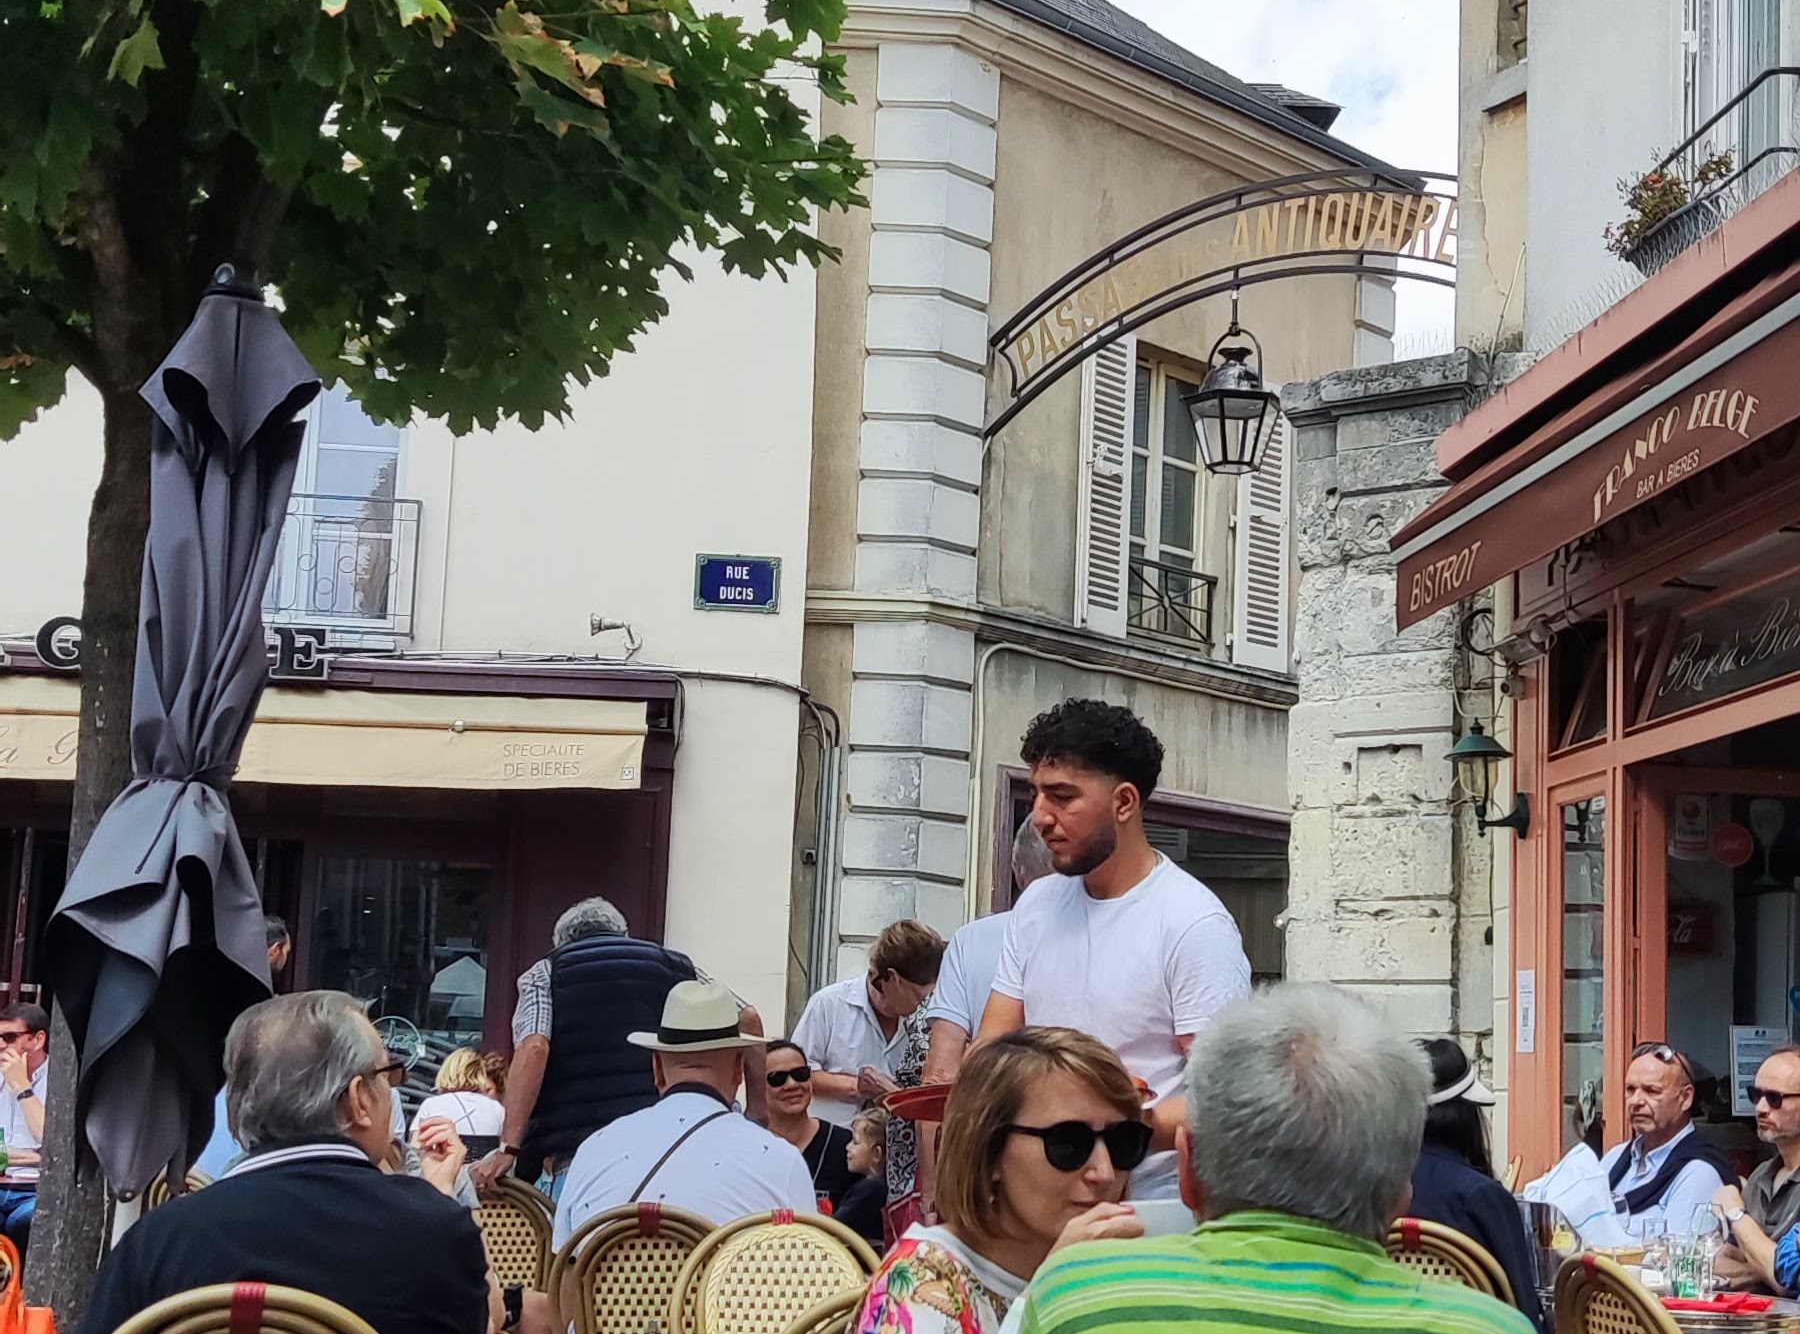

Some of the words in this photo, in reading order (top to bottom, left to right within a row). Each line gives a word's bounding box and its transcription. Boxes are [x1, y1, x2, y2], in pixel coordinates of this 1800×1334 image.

[1593, 406, 1681, 524] FRANCO
[1687, 389, 1760, 439] BELGE
[1636, 474, 1655, 499] BAR
[1655, 469, 1664, 490] A
[1666, 448, 1700, 483] BIERES
[726, 565, 751, 580] RUE
[1409, 540, 1482, 612] BISTROT
[719, 586, 754, 601] DUCIS
[503, 762, 525, 777] DE
[530, 761, 580, 776] BIERES
